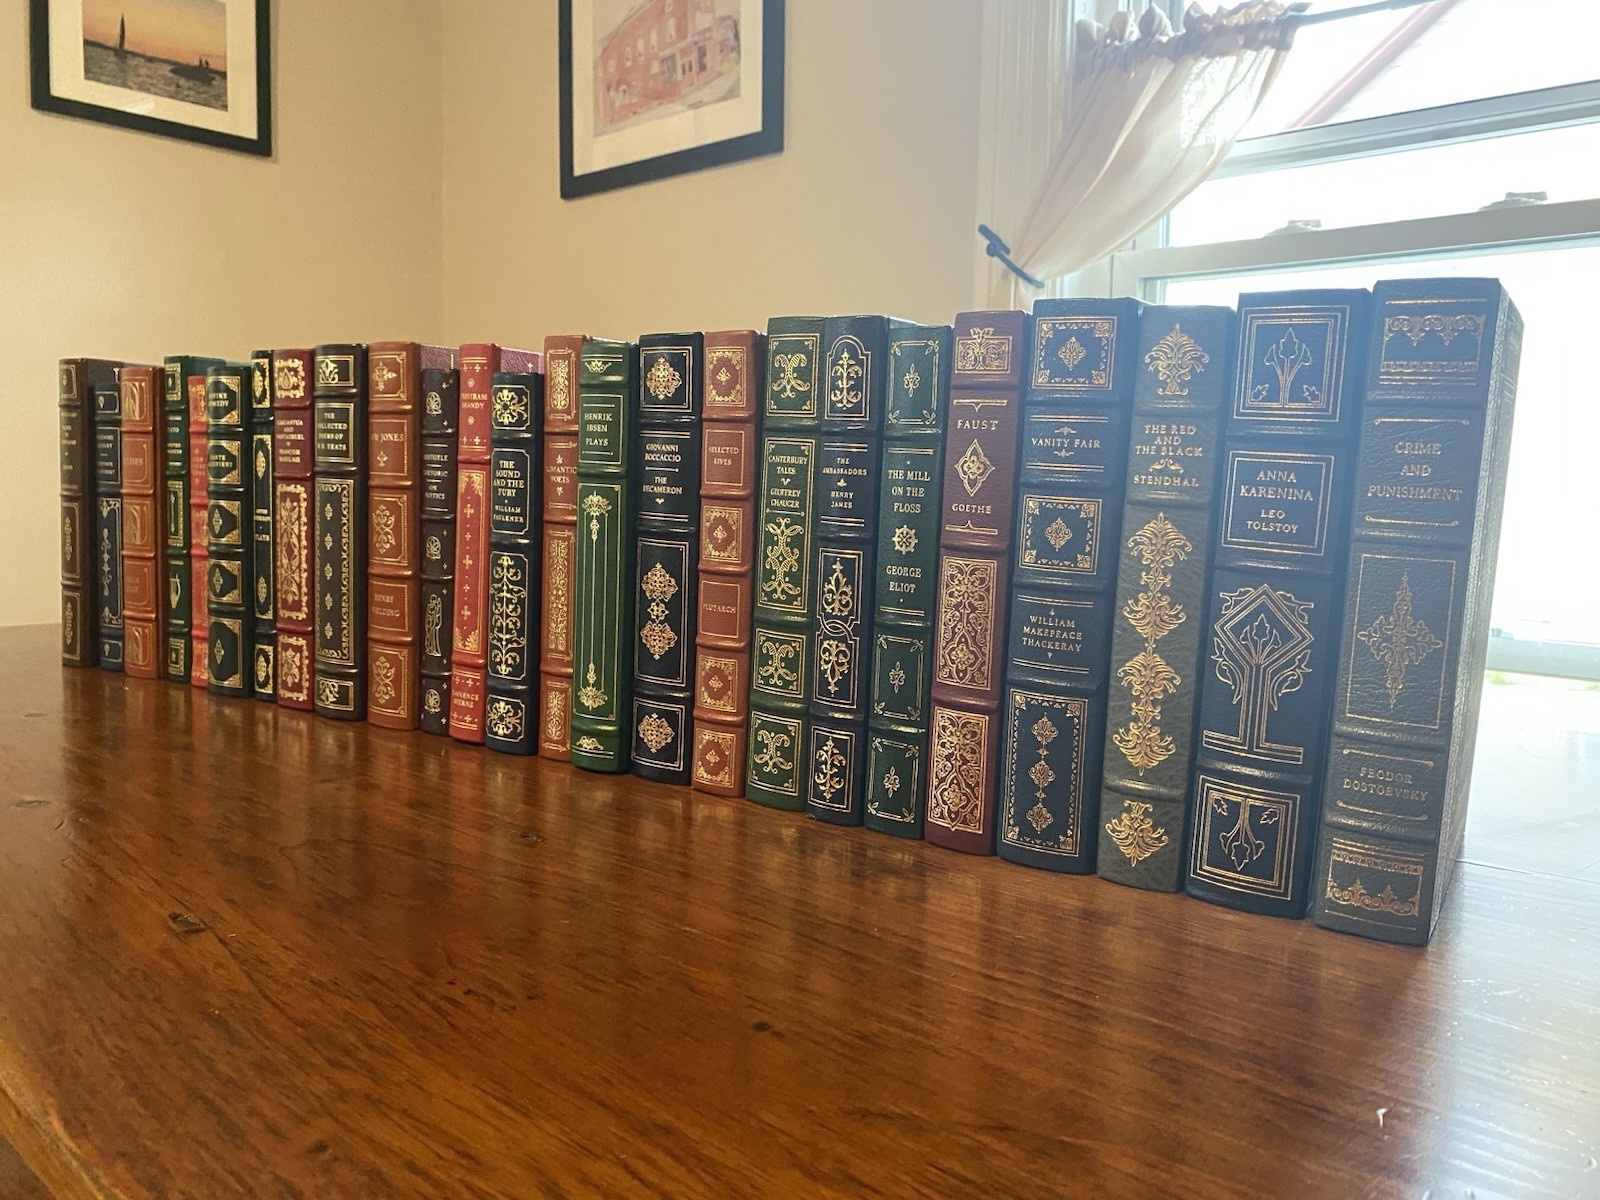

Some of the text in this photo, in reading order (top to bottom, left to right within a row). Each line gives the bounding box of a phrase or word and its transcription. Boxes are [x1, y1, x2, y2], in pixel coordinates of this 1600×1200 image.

[584, 412, 613, 422] HENRIK
[586, 423, 608, 433] IBSEN
[956, 419, 999, 431] FAUST
[1143, 424, 1197, 435] THE RED
[585, 437, 609, 447] PLAYS
[1031, 437, 1101, 449] VANITY FAIR
[1154, 435, 1182, 446] AND
[645, 443, 679, 452] GIOVANNI
[708, 445, 740, 455] SELECTED
[1134, 445, 1203, 457] THE BLACK
[1394, 441, 1442, 455] CRIME
[499, 460, 515, 469] THE
[768, 455, 808, 465] CANTERBURY
[837, 457, 850, 465] THE
[495, 469, 521, 479] SOUND
[776, 466, 796, 475] TALES
[822, 467, 868, 477] AMBASSADORS
[888, 469, 931, 482] THE MILL
[1400, 464, 1432, 477] AND
[654, 476, 668, 484] THE
[1133, 474, 1199, 488] STENDHAL
[1256, 470, 1297, 483] ANNA
[493, 478, 525, 489] AND THE
[498, 488, 517, 497] FURY
[642, 485, 683, 495] DECAMERON
[770, 488, 802, 498] GEOFFREY
[830, 490, 854, 500] HENRY
[891, 485, 925, 498] ON THE
[1239, 484, 1314, 501] KARENINA
[1367, 484, 1463, 501] PUNISHMENT
[494, 504, 521, 514] WILLIAM
[770, 499, 801, 509] CHAUCER
[830, 500, 853, 509] JAMES
[893, 502, 922, 514] FLOSS
[951, 503, 993, 514] GOETHE
[1260, 509, 1286, 519] LEO
[1246, 520, 1299, 534] TOLSTOY
[886, 565, 922, 578] GEORGE
[889, 581, 917, 593] ELIOT
[702, 602, 737, 614] PLUTARCH
[1029, 615, 1075, 628] WILLIAM
[1022, 625, 1082, 640] MAKEPEACE
[1021, 637, 1082, 652] THACKERAY
[1359, 766, 1413, 785] FEODOR
[1343, 777, 1428, 802] DOSTOEVSKY
